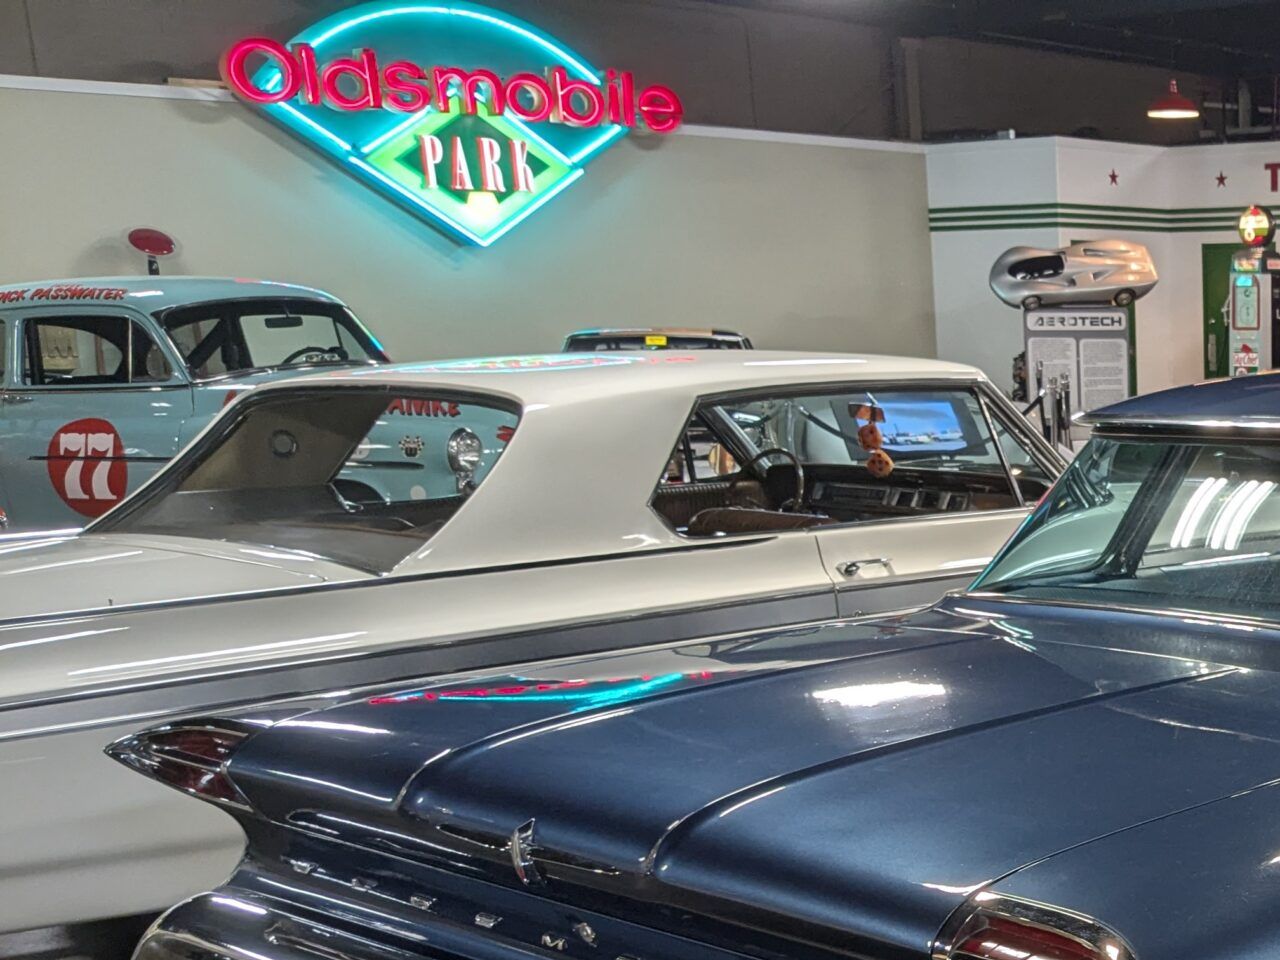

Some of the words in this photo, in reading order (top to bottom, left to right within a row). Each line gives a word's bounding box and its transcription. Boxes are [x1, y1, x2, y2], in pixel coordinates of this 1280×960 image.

[219, 38, 685, 134] Oldsmobile
[419, 134, 535, 192] PARK
[0, 287, 30, 303] ICK
[29, 287, 129, 301] PASSWATER
[1034, 316, 1122, 327] AEROTECH
[60, 432, 118, 500] 77
